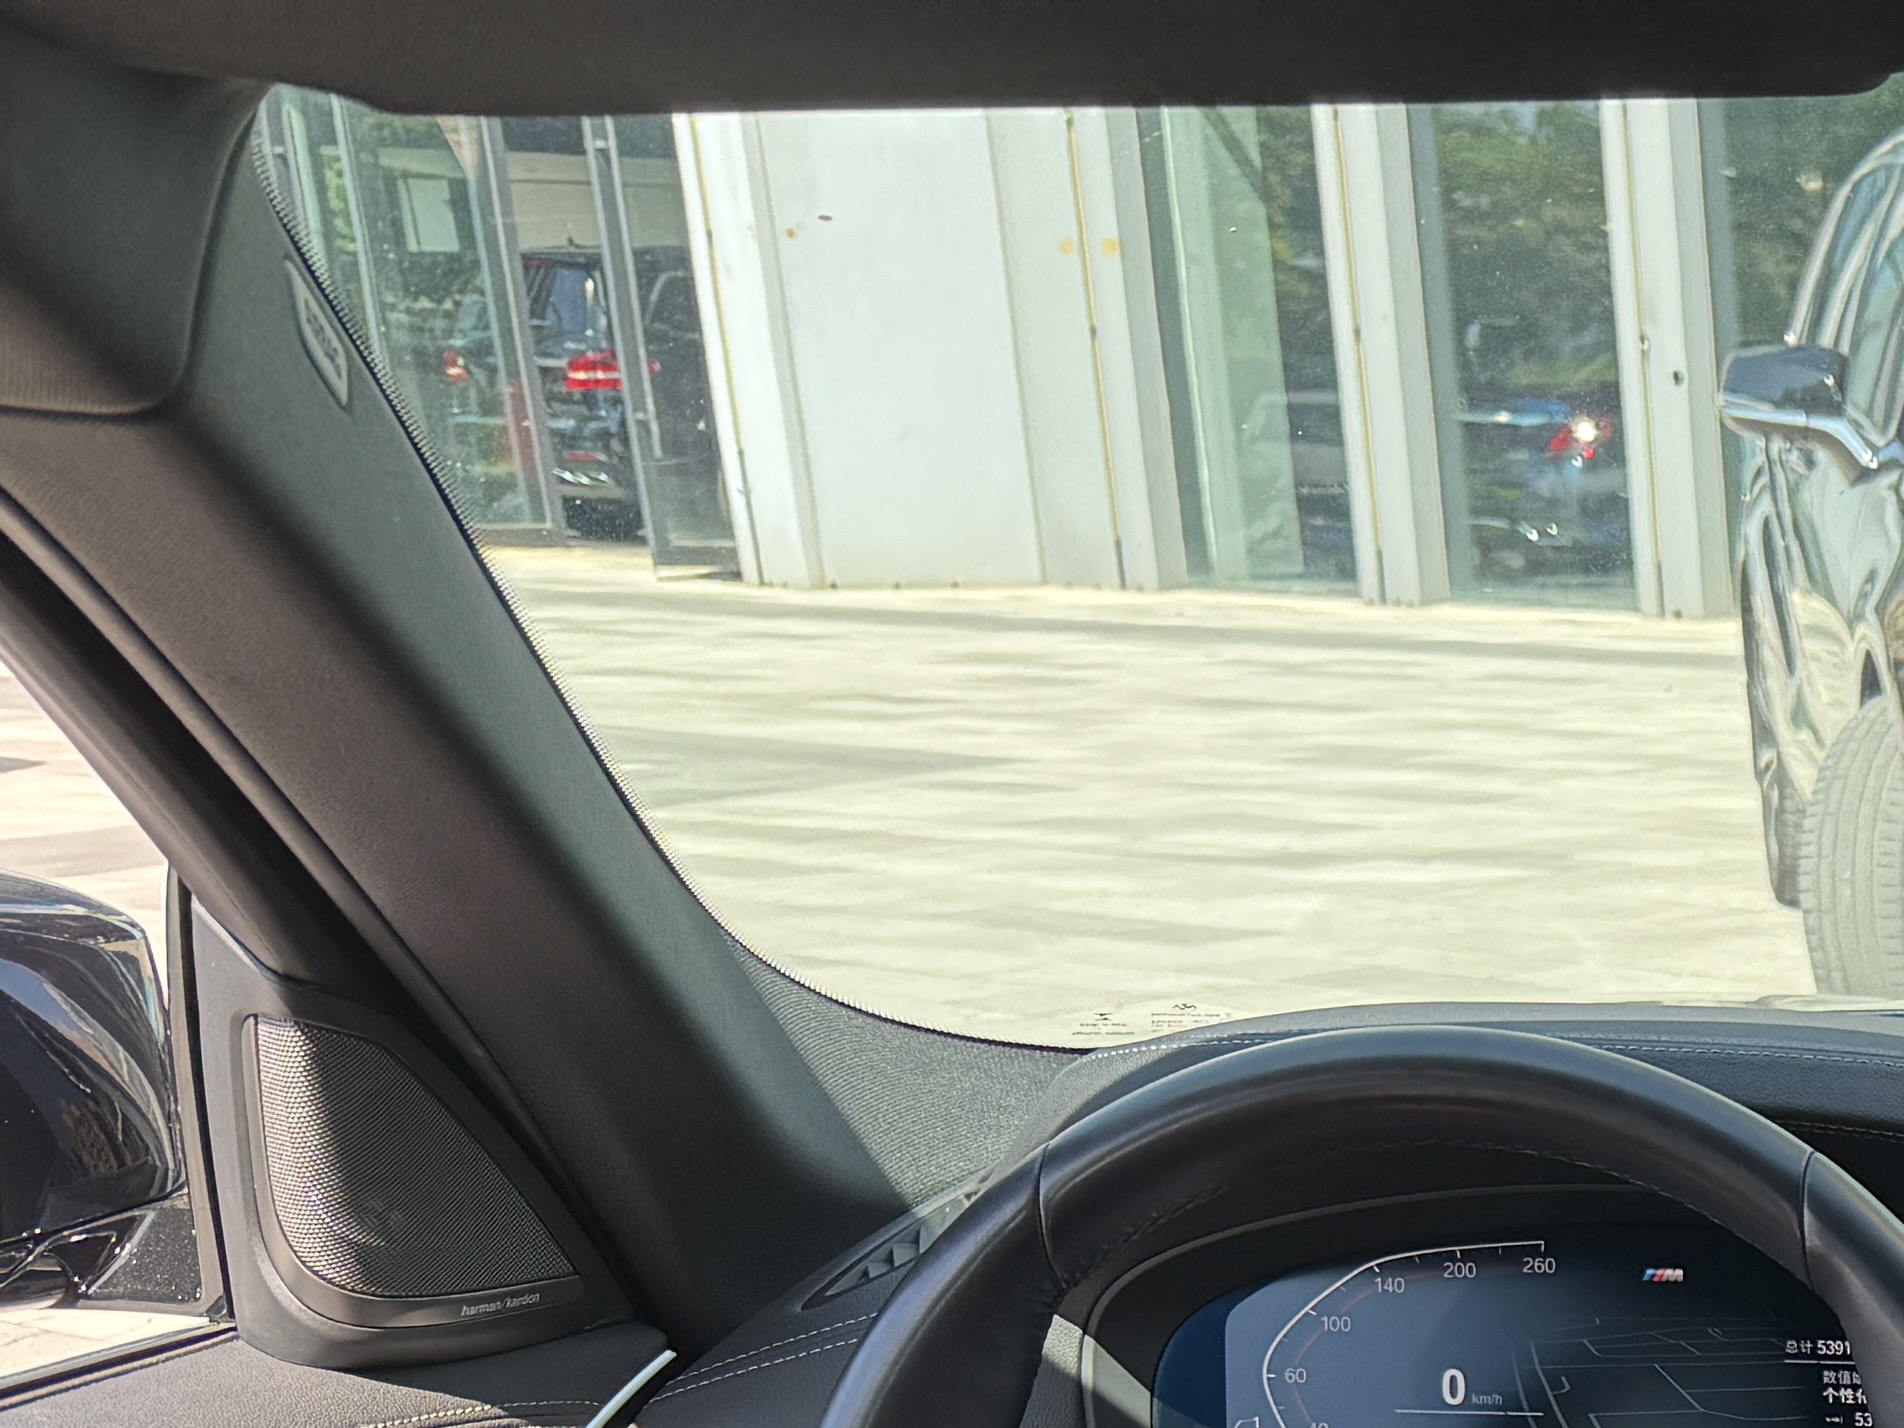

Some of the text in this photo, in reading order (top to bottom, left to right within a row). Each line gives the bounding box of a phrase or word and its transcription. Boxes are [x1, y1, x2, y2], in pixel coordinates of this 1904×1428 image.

[1443, 1262, 1477, 1279] 200
[1522, 1257, 1556, 1275] 260
[1374, 1277, 1405, 1295] 140
[1320, 1315, 1352, 1332] 100
[1785, 1340, 1813, 1355] 总计
[1284, 1368, 1307, 1384] 60
[1442, 1369, 1503, 1407] 0 km/h
